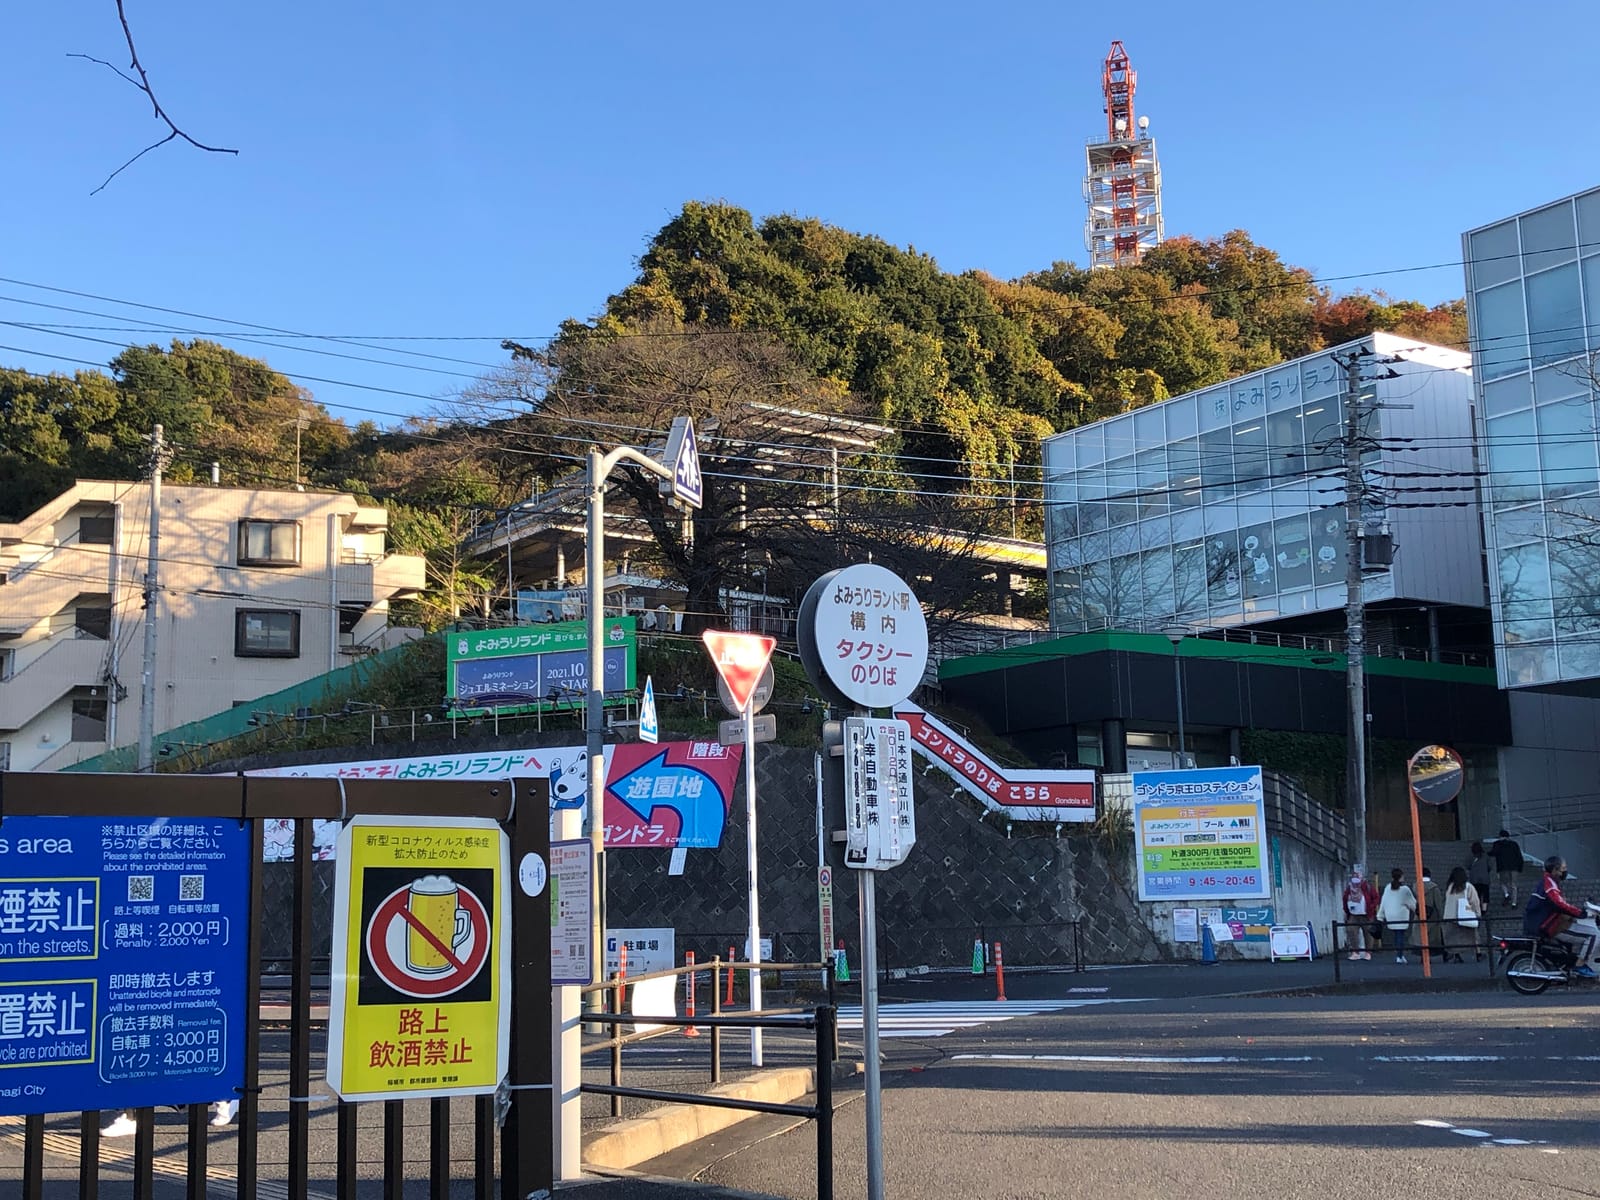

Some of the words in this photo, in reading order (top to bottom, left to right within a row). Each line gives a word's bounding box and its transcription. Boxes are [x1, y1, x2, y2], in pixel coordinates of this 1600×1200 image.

[834, 585, 910, 611] よみうりランド駅
[475, 634, 552, 651] よみうりランド
[836, 639, 912, 661] タクシー
[547, 663, 584, 679] 2021.10
[851, 664, 897, 686] のりば
[459, 679, 538, 695] ジュエルミネーション
[691, 742, 724, 757] 階段
[917, 724, 1002, 794] ゴンドラのりば
[1009, 786, 1051, 800] こちら
[626, 776, 704, 798] 遊園地
[1055, 797, 1080, 805] Gondola
[17, 838, 73, 854] area
[101, 838, 220, 849] ちらからご覧ください。
[366, 834, 490, 848] 新型コロナウィルス感染症
[103, 852, 128, 860] Please
[144, 851, 156, 860] the
[158, 851, 186, 860] detailed
[187, 851, 226, 860] information
[394, 848, 468, 860] 拡大防止のため
[103, 863, 128, 872] about
[130, 863, 143, 871] the
[145, 862, 184, 872] prohibited
[186, 863, 208, 871] areas.
[1227, 909, 1270, 921] スロープ
[18, 938, 40, 953] the
[43, 938, 91, 953] streets.
[192, 937, 210, 946] Yen
[624, 940, 659, 951] 駐車場
[109, 970, 215, 989] 即時撤去します
[109, 991, 149, 1000] Unattended
[150, 989, 172, 999] bicycle
[173, 989, 186, 997] and
[187, 987, 221, 996] motorcycle
[109, 1003, 122, 1012] will
[124, 1002, 135, 1011] be
[137, 1001, 172, 1010] removed
[173, 999, 219, 1009] immediately.
[0, 992, 85, 1040] 置禁止
[111, 1014, 174, 1032] 撤去手数料
[178, 1018, 208, 1027] Removal
[398, 1008, 449, 1035] 路上
[19, 1047, 36, 1060] are
[38, 1040, 88, 1059] prohibited.
[369, 1037, 473, 1068] 飲酒禁止
[24, 1084, 46, 1096] City
